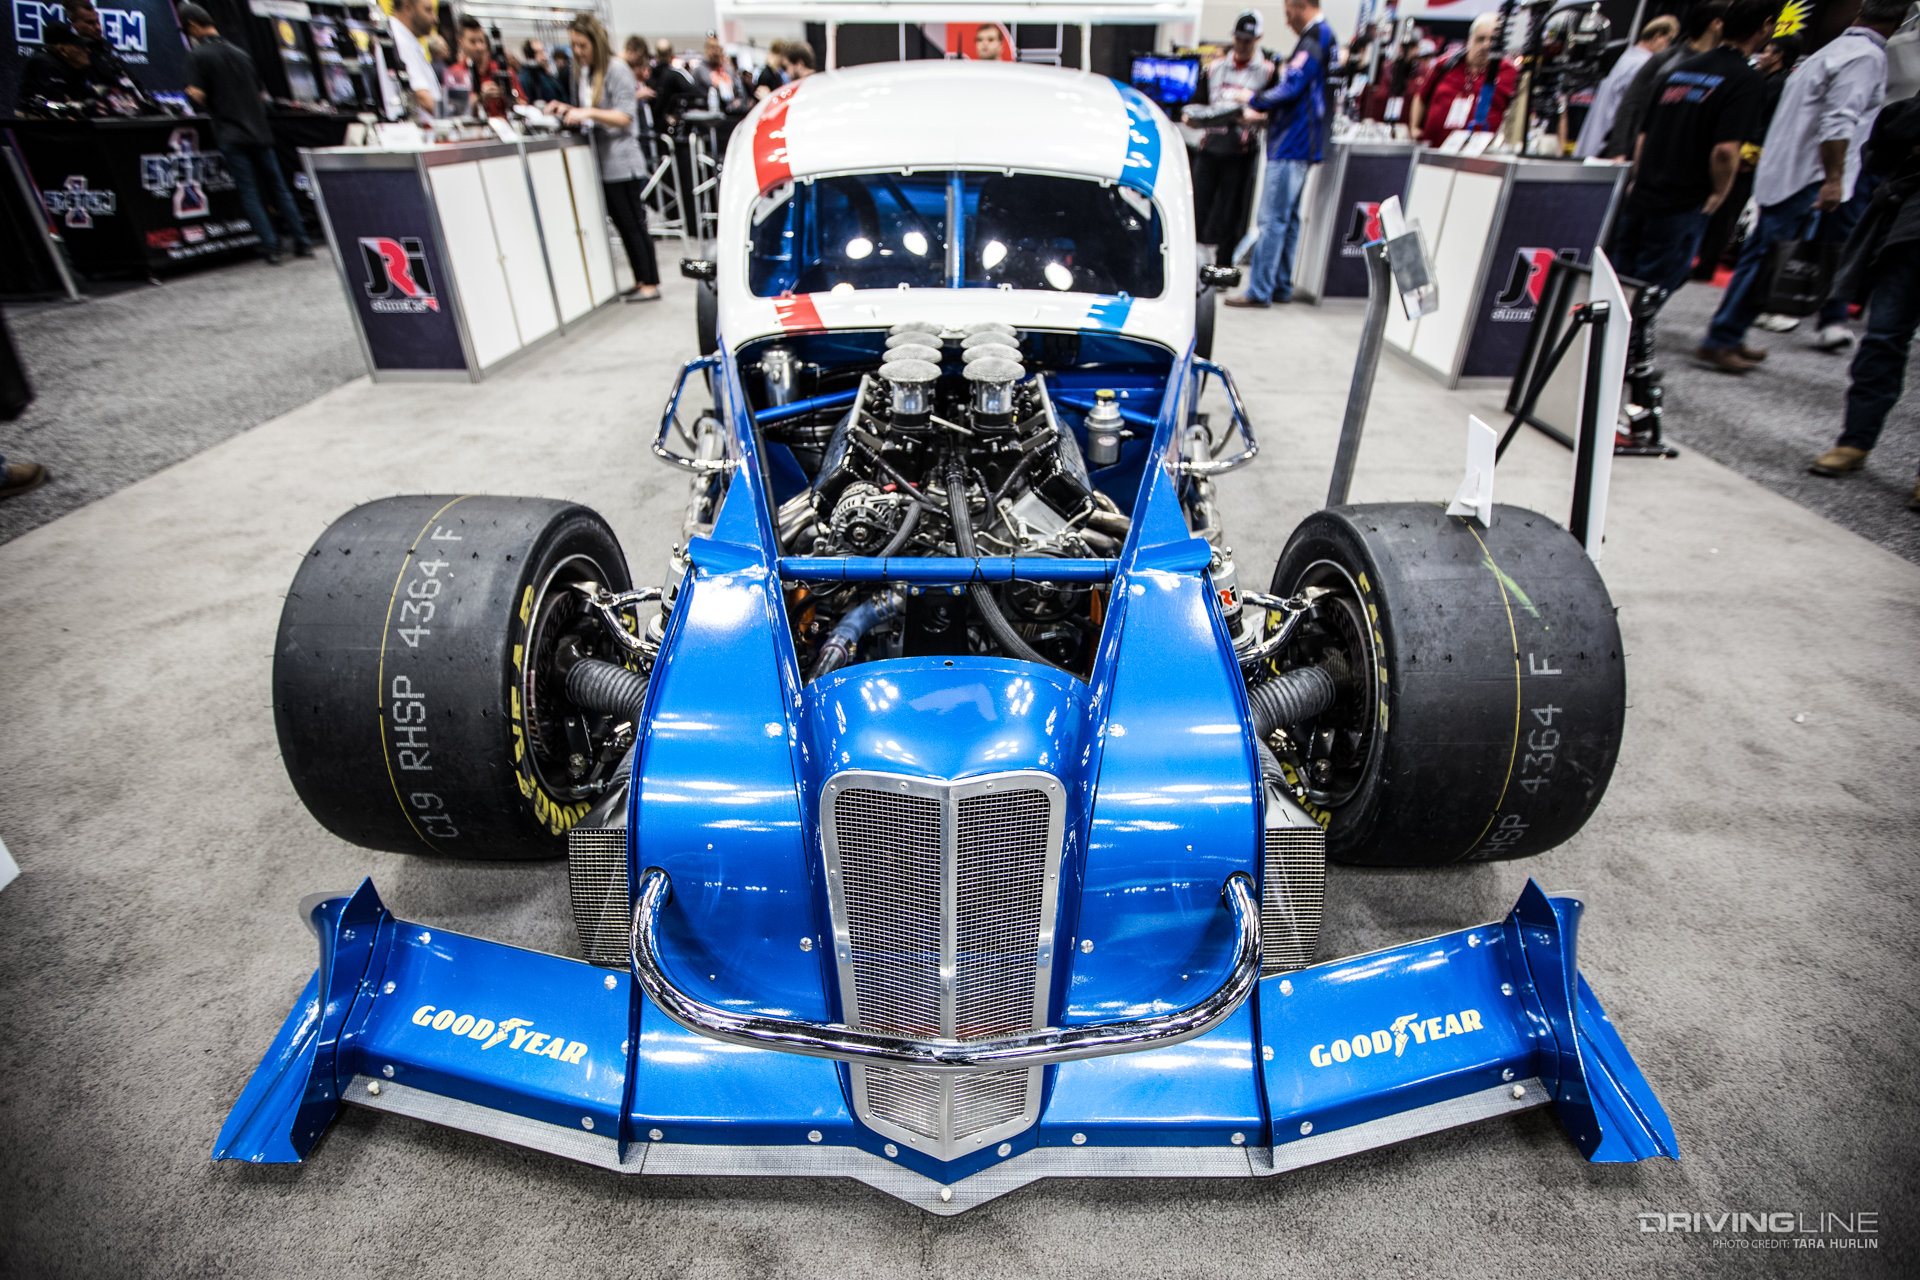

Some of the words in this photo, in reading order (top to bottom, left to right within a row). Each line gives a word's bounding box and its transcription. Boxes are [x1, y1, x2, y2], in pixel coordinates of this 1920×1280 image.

[12, 0, 149, 52] SYEM
[431, 526, 463, 541] F
[398, 559, 450, 647] 4364
[1528, 653, 1562, 675] F
[392, 675, 433, 770] RHSP
[1519, 704, 1563, 794] 4364
[410, 792, 460, 838] C19
[411, 1005, 588, 1065] GOODYEAR
[1309, 1009, 1484, 1068] GOODYEAR
